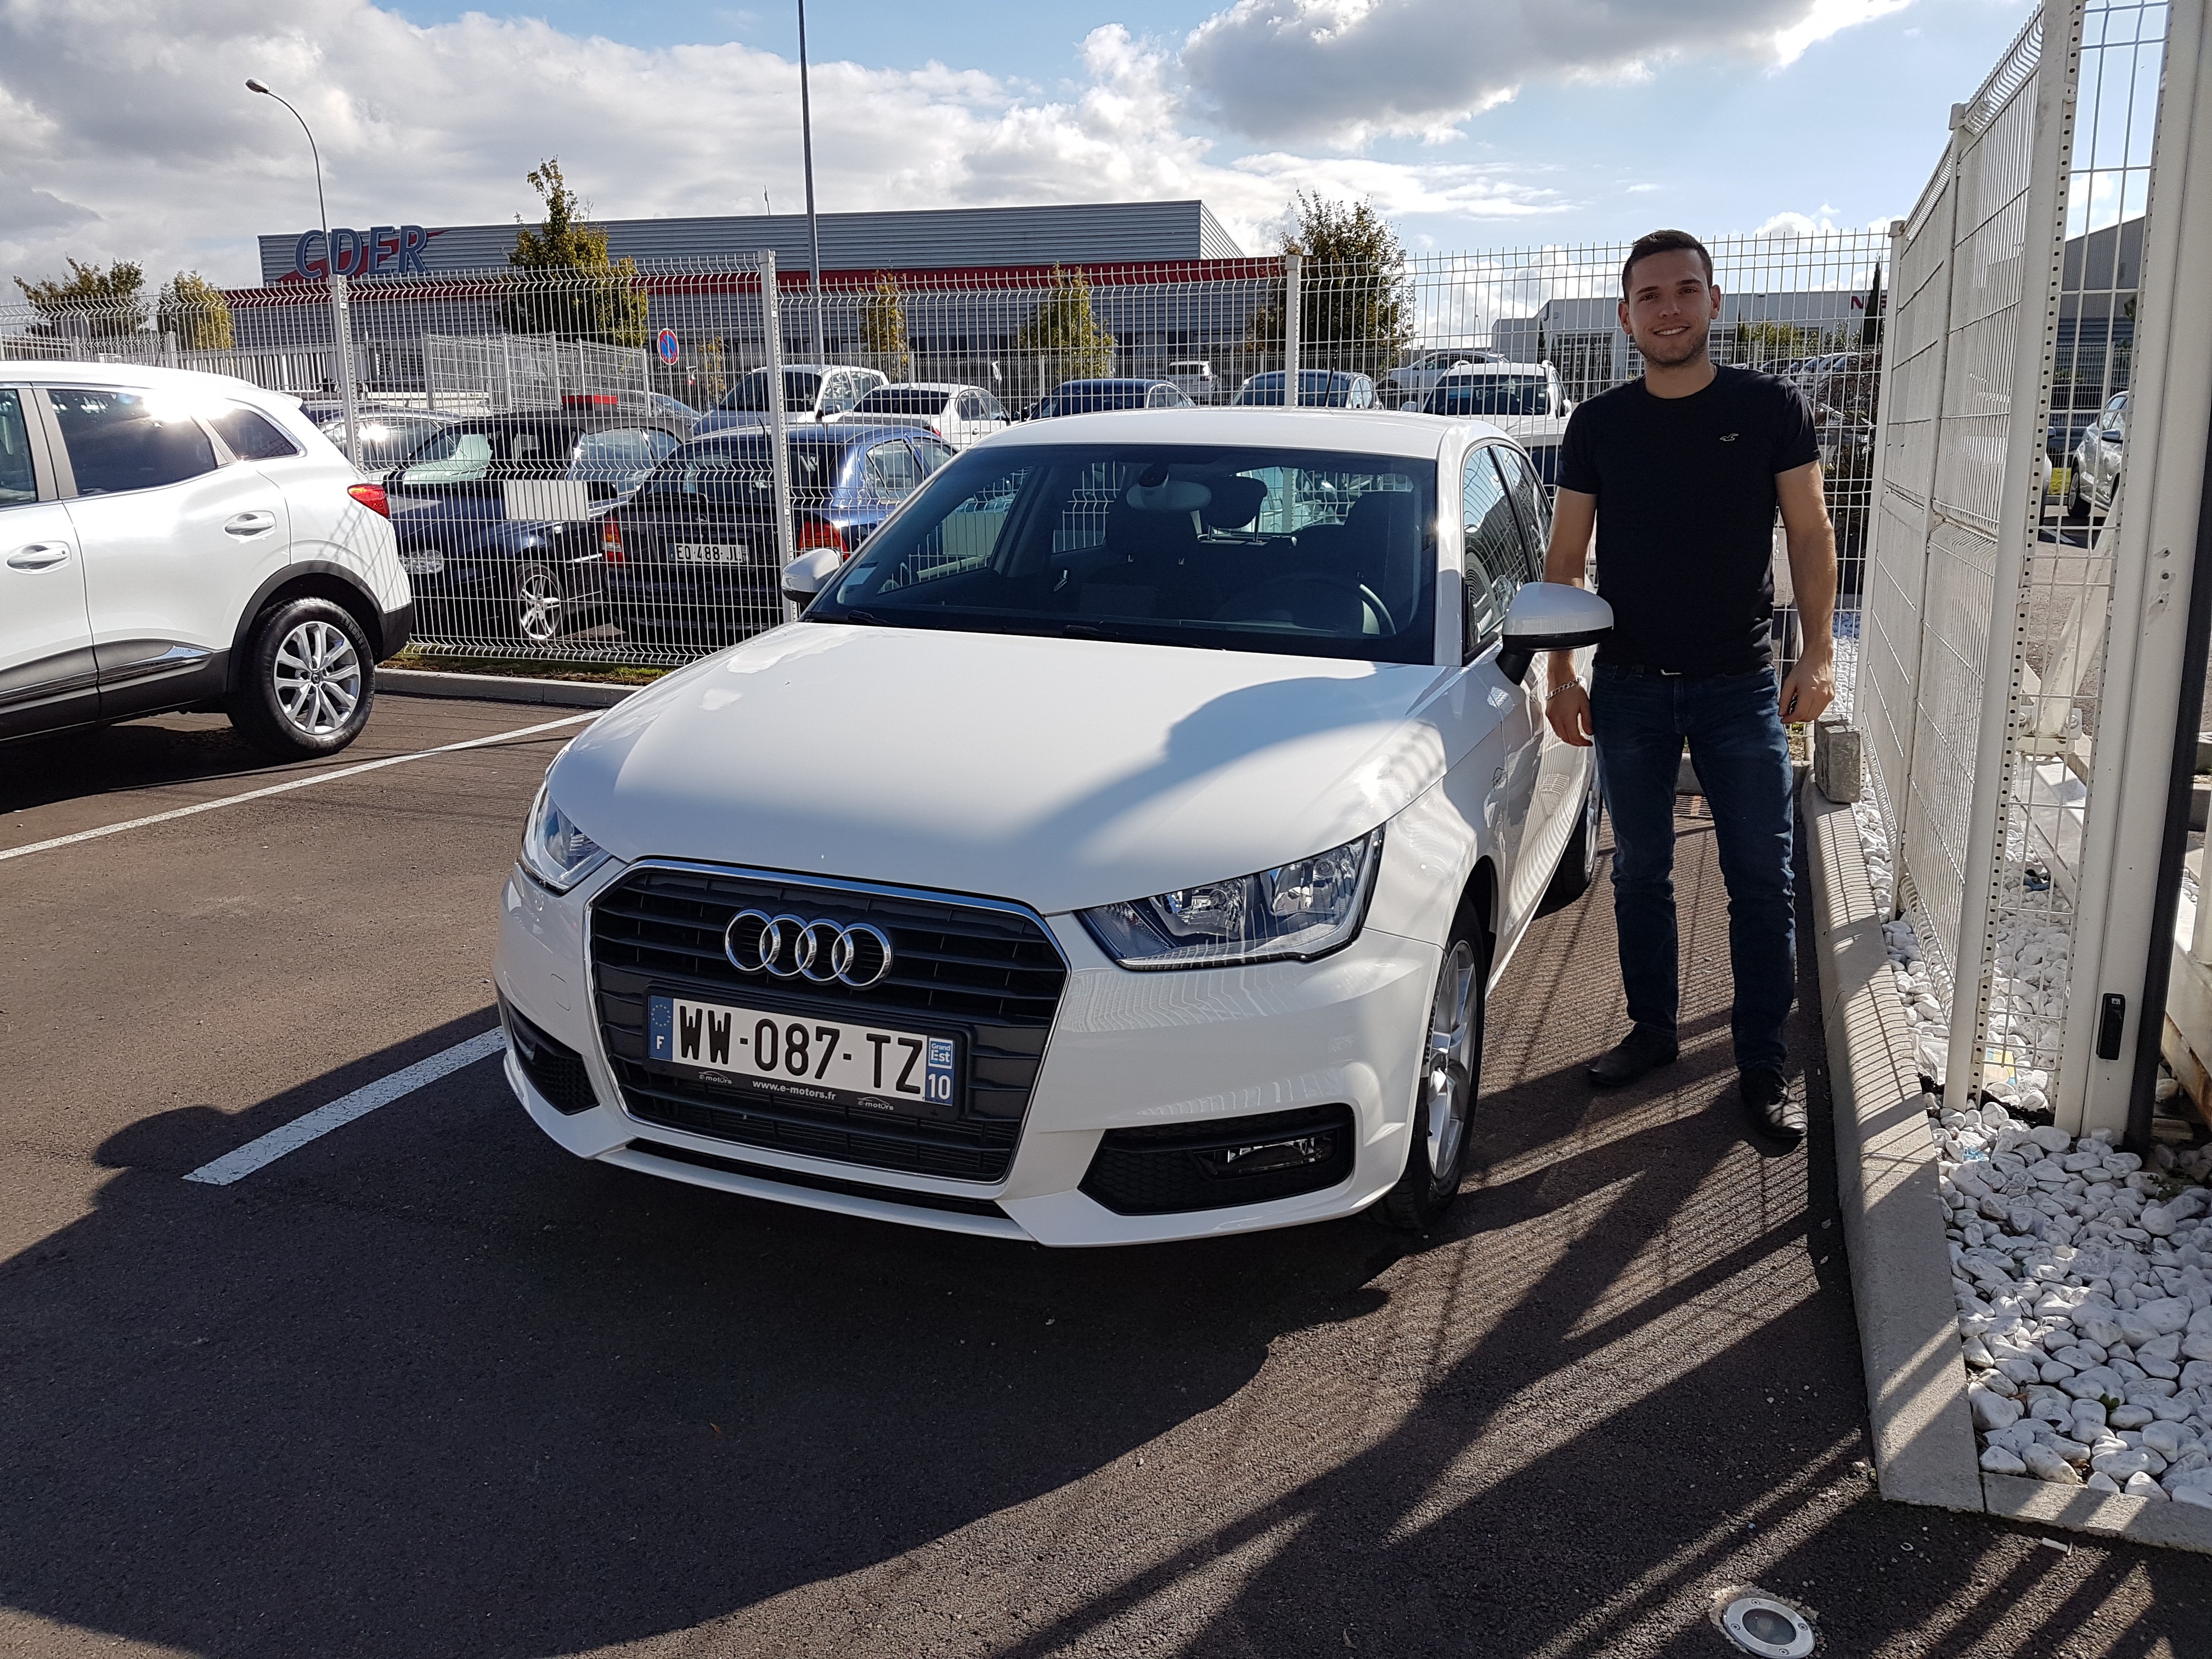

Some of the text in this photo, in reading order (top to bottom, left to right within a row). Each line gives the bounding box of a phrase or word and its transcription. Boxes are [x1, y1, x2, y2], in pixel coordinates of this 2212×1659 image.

[295, 225, 430, 279] CDER
[656, 1035, 664, 1049] F
[931, 1043, 951, 1051] Grand
[930, 1049, 950, 1063] Est
[752, 1080, 836, 1101] www.e-motors.fr
[928, 1073, 951, 1099] 10
